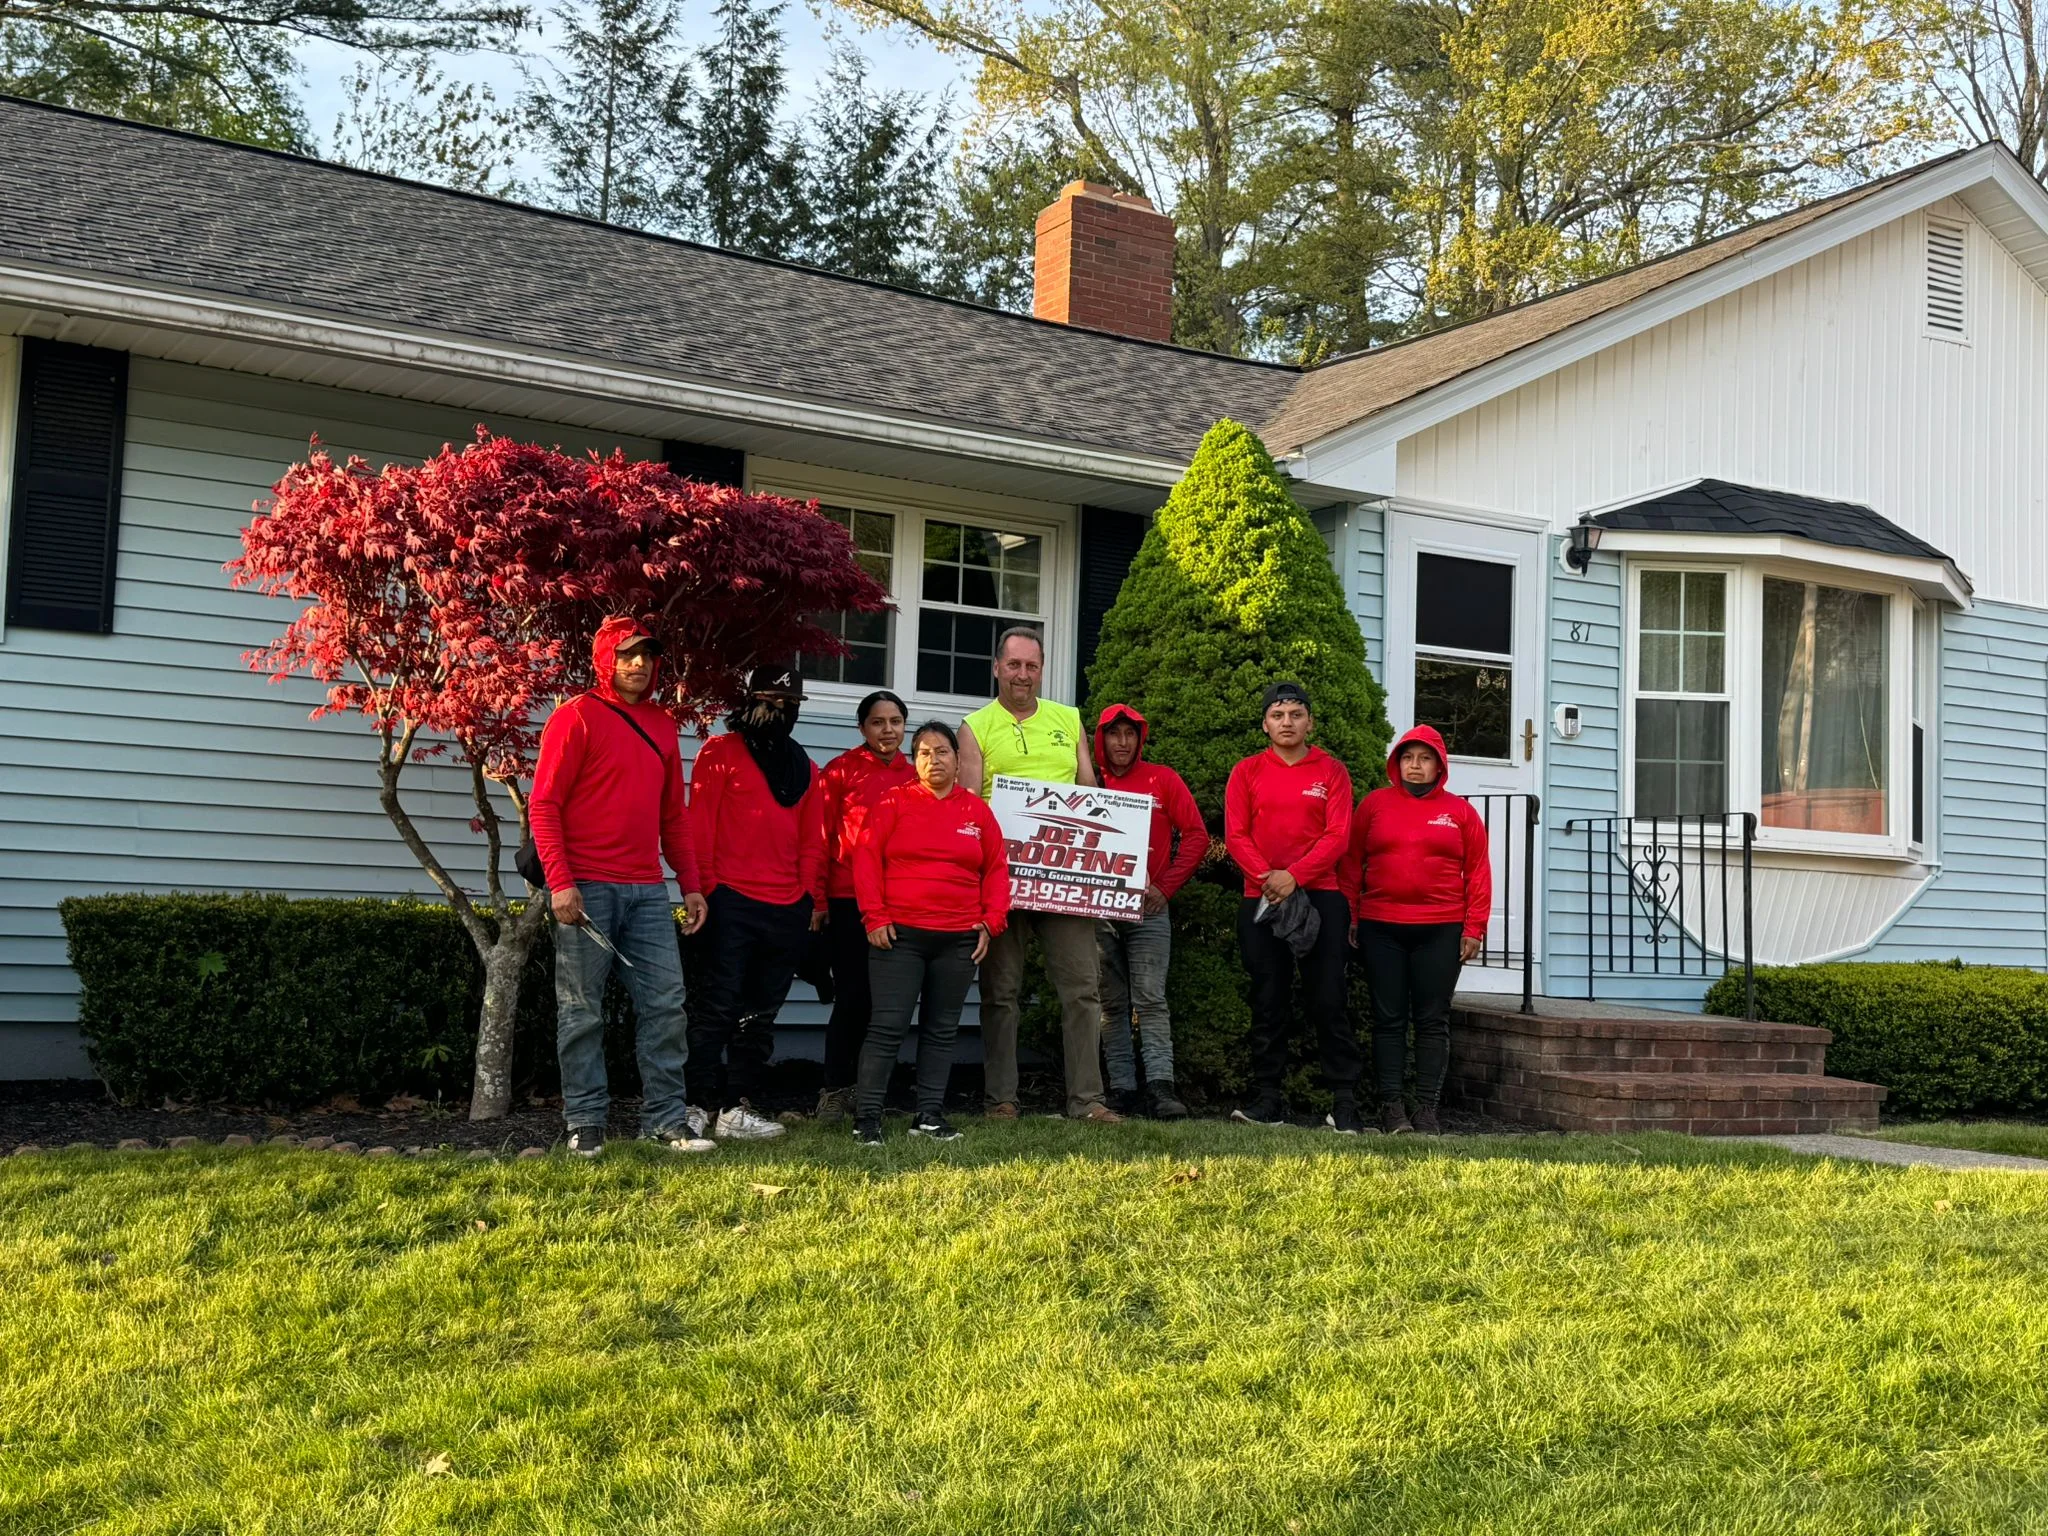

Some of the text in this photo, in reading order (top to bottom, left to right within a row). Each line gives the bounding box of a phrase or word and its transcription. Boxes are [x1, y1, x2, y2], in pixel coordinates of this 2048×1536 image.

[1570, 620, 1591, 642] 81
[772, 671, 791, 688] A
[1009, 779, 1031, 787] serve
[1103, 799, 1122, 808] Fully
[1122, 801, 1149, 811] Insured
[1113, 794, 1149, 805] Estimates
[1029, 824, 1103, 849] JOE'S
[1003, 838, 1138, 877] ROOFING
[1014, 867, 1118, 888] 100% Guaranteed
